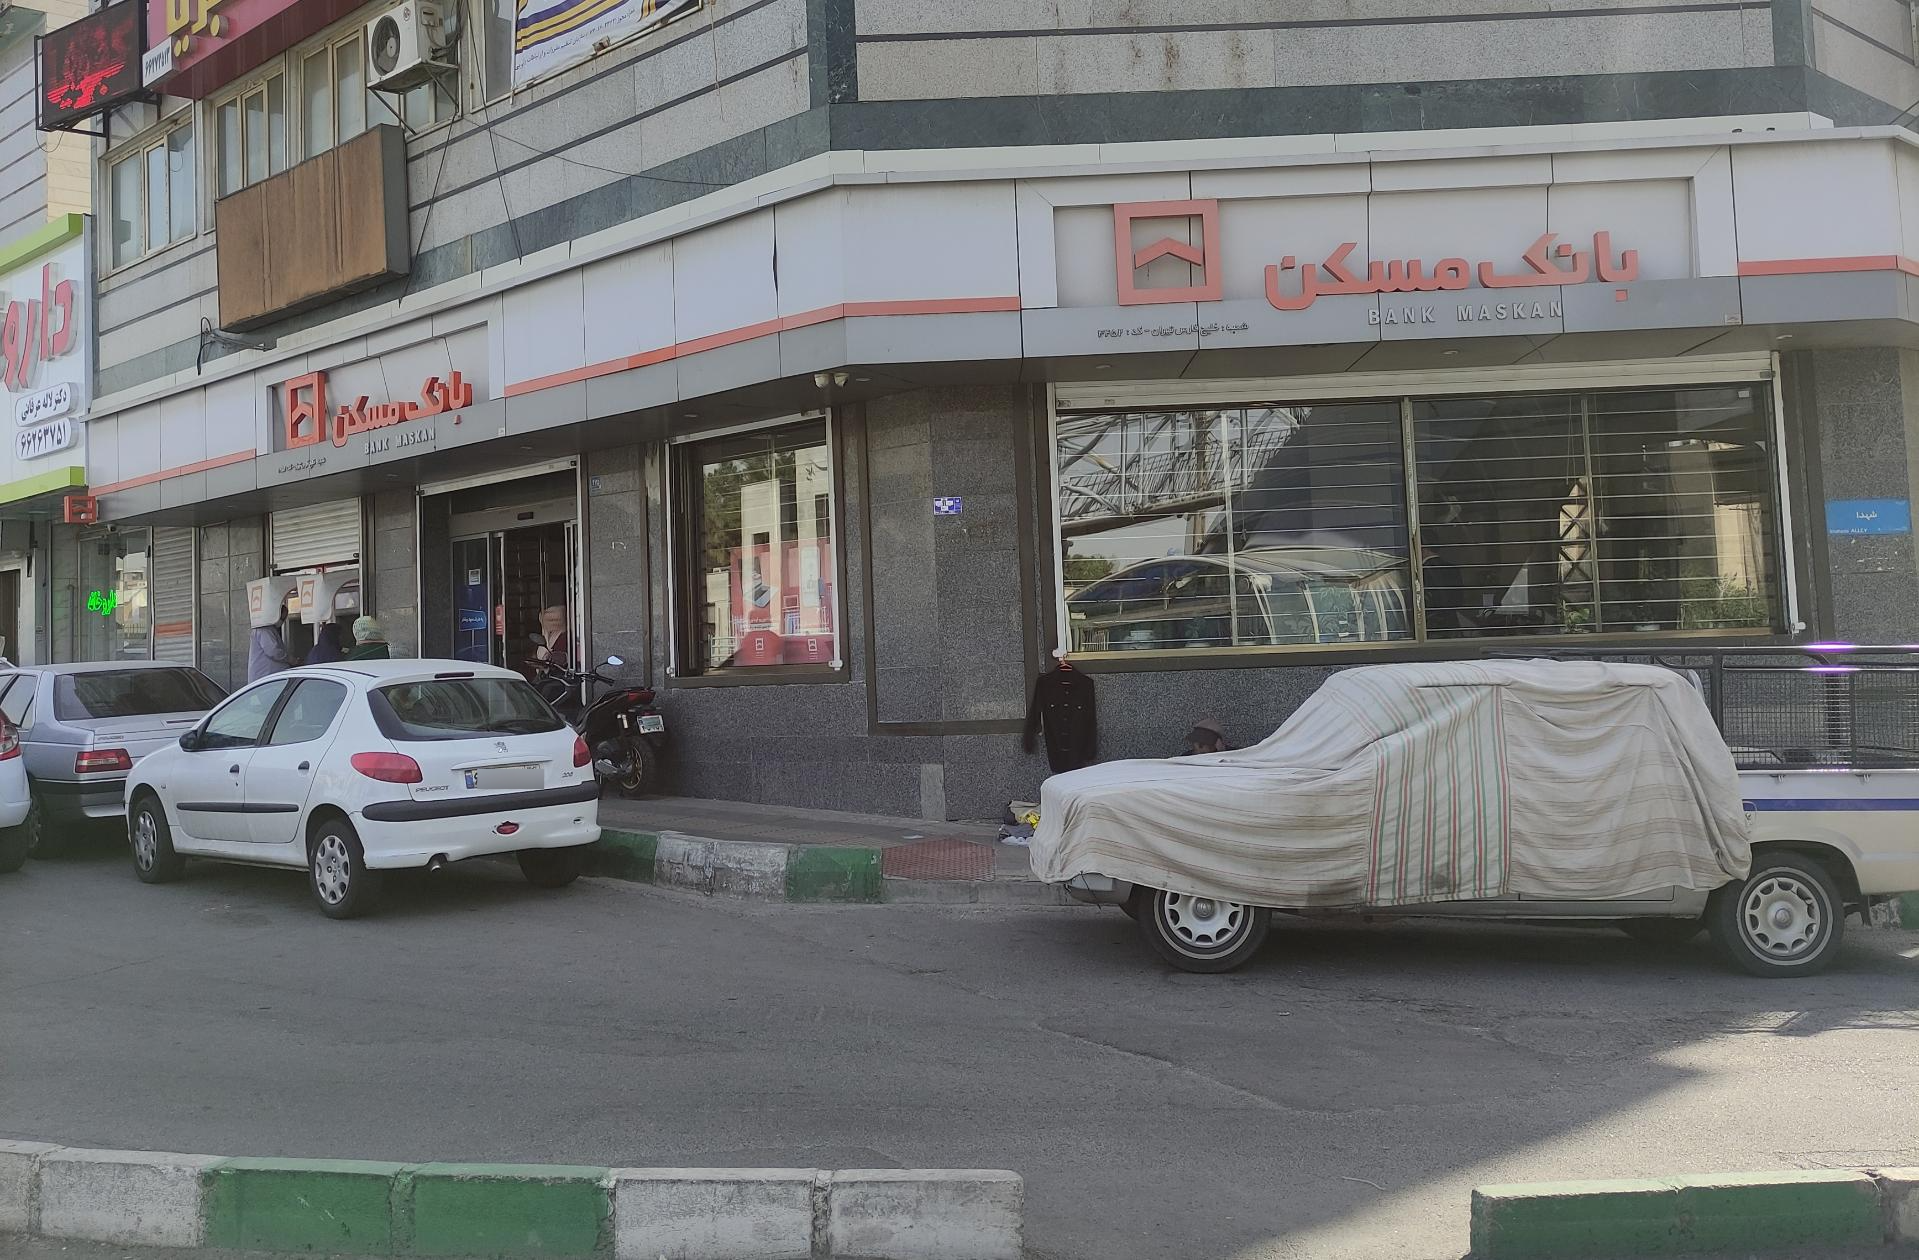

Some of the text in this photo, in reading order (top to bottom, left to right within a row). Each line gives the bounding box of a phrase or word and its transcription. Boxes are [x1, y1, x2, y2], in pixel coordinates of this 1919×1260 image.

[1264, 231, 1638, 311] بانک مسکن
[2, 262, 76, 392] دارو
[1368, 300, 1563, 325] BANK MASKAN
[332, 371, 473, 448] بانک مسکن
[364, 427, 436, 455] BANK MASKAN
[1856, 509, 1878, 521] شهدا
